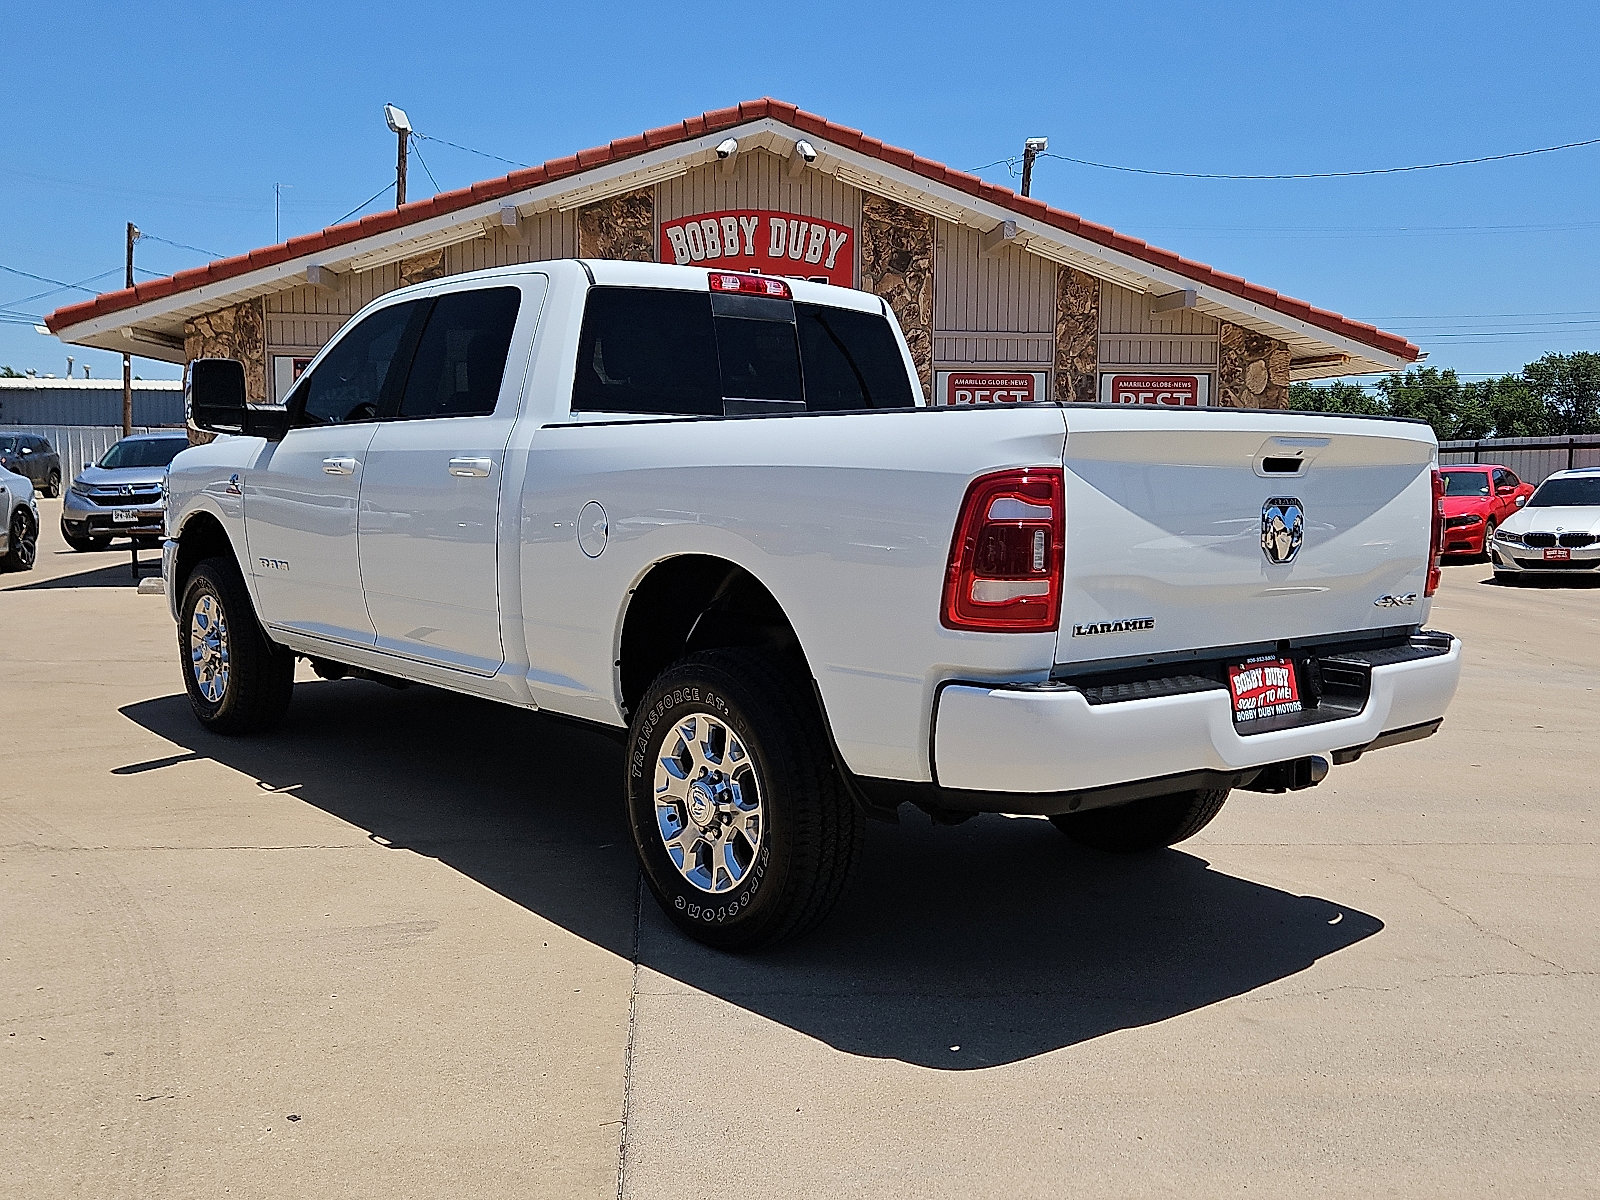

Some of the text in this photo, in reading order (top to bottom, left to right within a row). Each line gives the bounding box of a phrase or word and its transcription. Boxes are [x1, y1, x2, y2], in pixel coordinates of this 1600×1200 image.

[665, 216, 848, 269] BOBBY DUBY
[258, 557, 290, 571] RAM
[1072, 617, 1155, 637] LARAMIE
[1233, 667, 1289, 695] BOBBY DUBY
[1237, 687, 1292, 709] SOLD IT TO ME!
[1236, 701, 1302, 721] BOBBY DUBY MOTORS
[632, 687, 700, 778] TRANSFORCE
